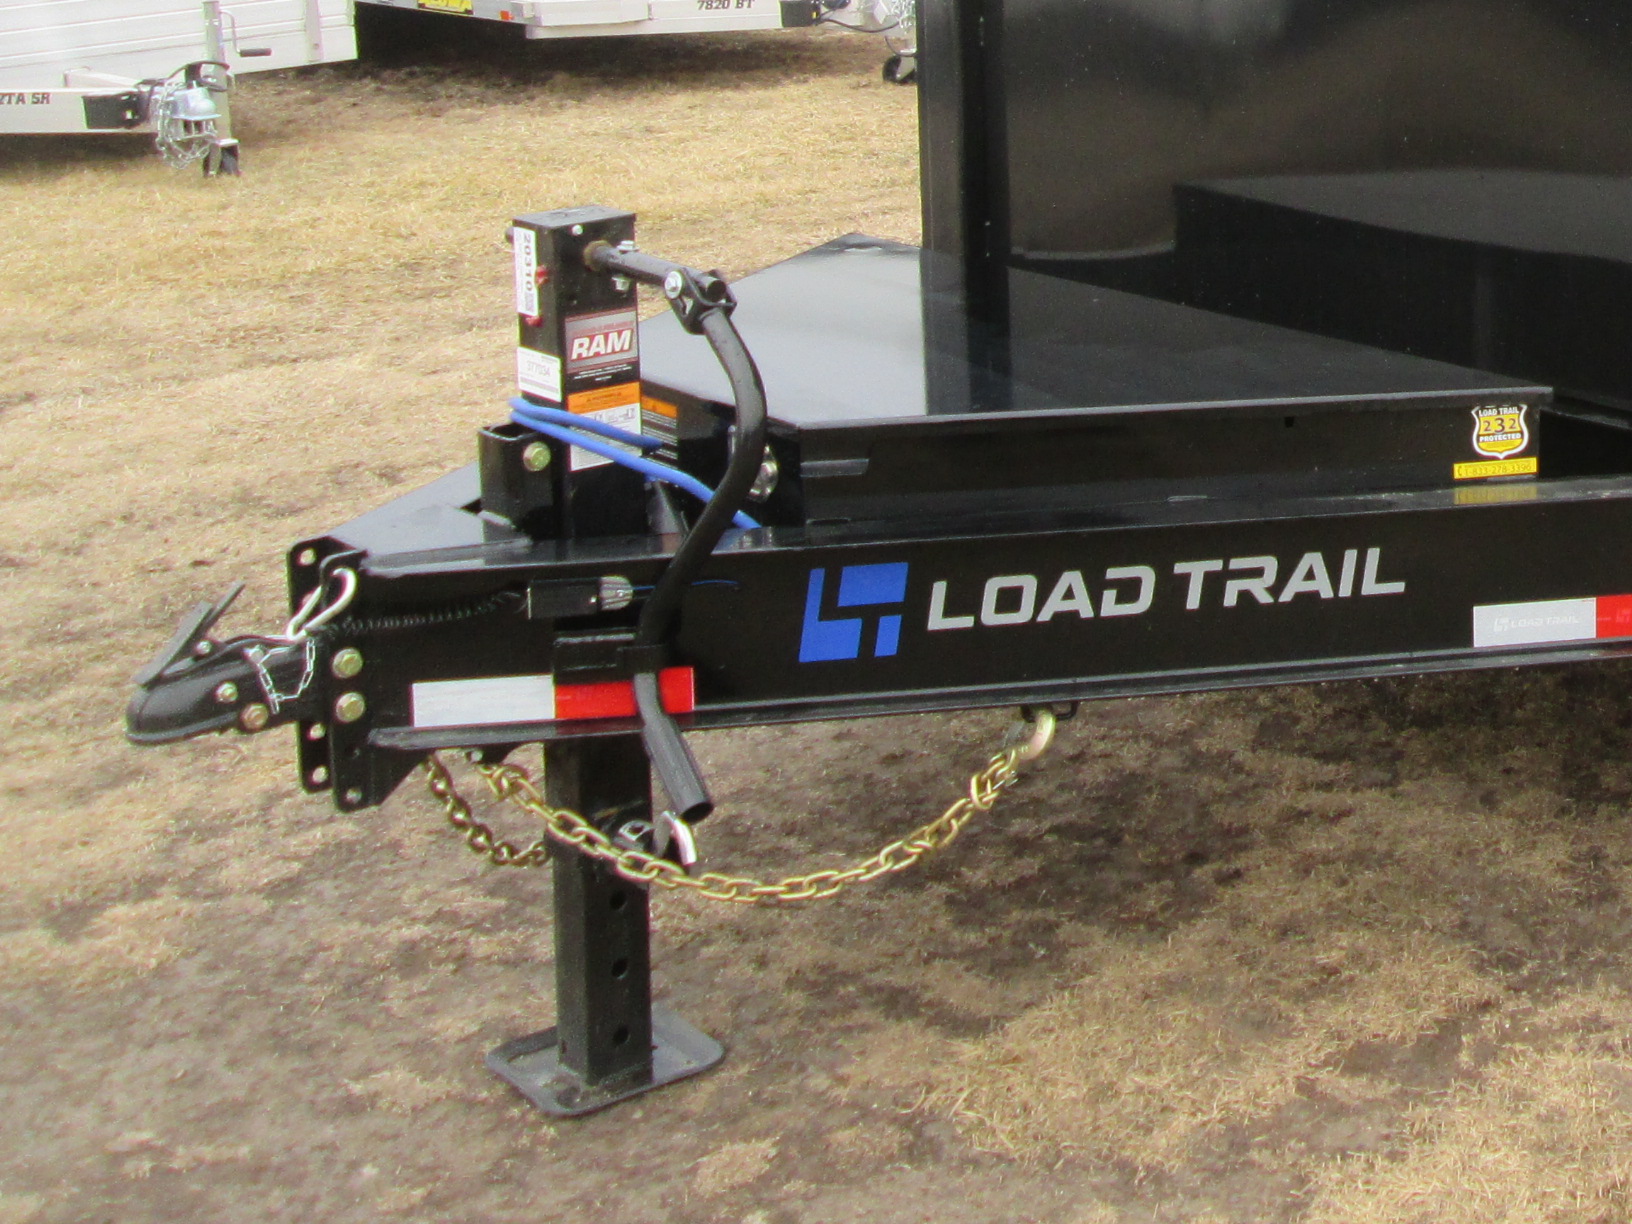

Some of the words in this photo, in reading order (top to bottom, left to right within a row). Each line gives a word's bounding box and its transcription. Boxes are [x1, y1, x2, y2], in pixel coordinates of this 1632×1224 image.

[31, 92, 51, 105] SR
[523, 232, 533, 292] 20310
[570, 328, 633, 362] RAM
[1479, 408, 1497, 417] LOAD
[1500, 406, 1519, 415] TRAIL
[1480, 432, 1521, 443] PROTECTED
[927, 565, 1157, 631] LOAD
[1173, 547, 1406, 610] TRAIL
